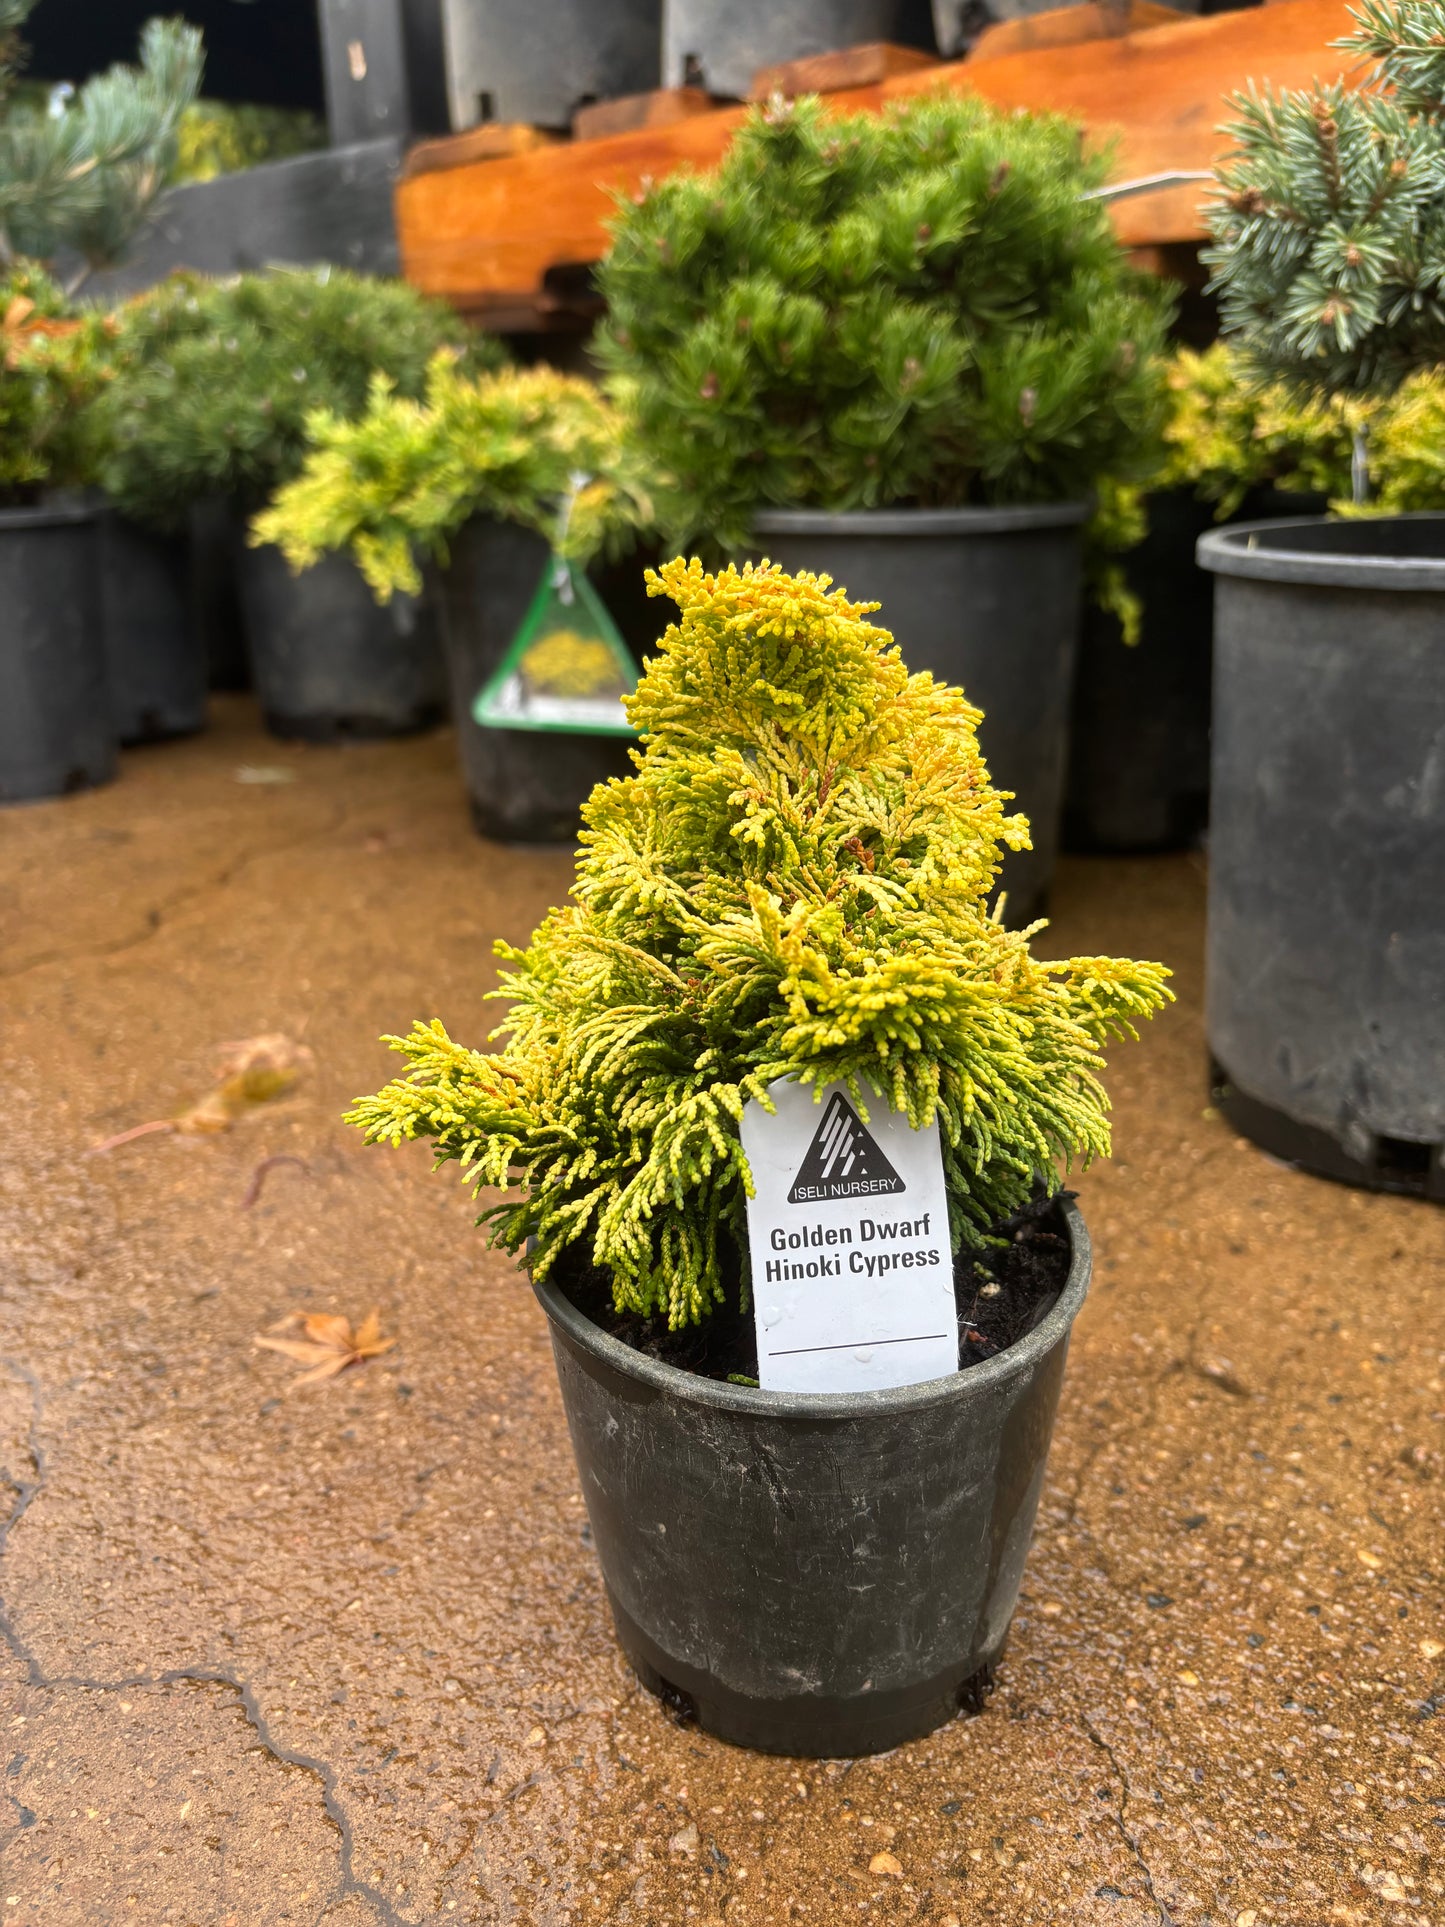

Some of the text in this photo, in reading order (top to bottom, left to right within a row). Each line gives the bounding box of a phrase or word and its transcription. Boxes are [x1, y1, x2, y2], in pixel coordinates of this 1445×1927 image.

[794, 1178, 898, 1200] ISELI NURSERY
[770, 1213, 931, 1251] Golden Dwarf
[765, 1248, 940, 1283] Hinoki Cypress
